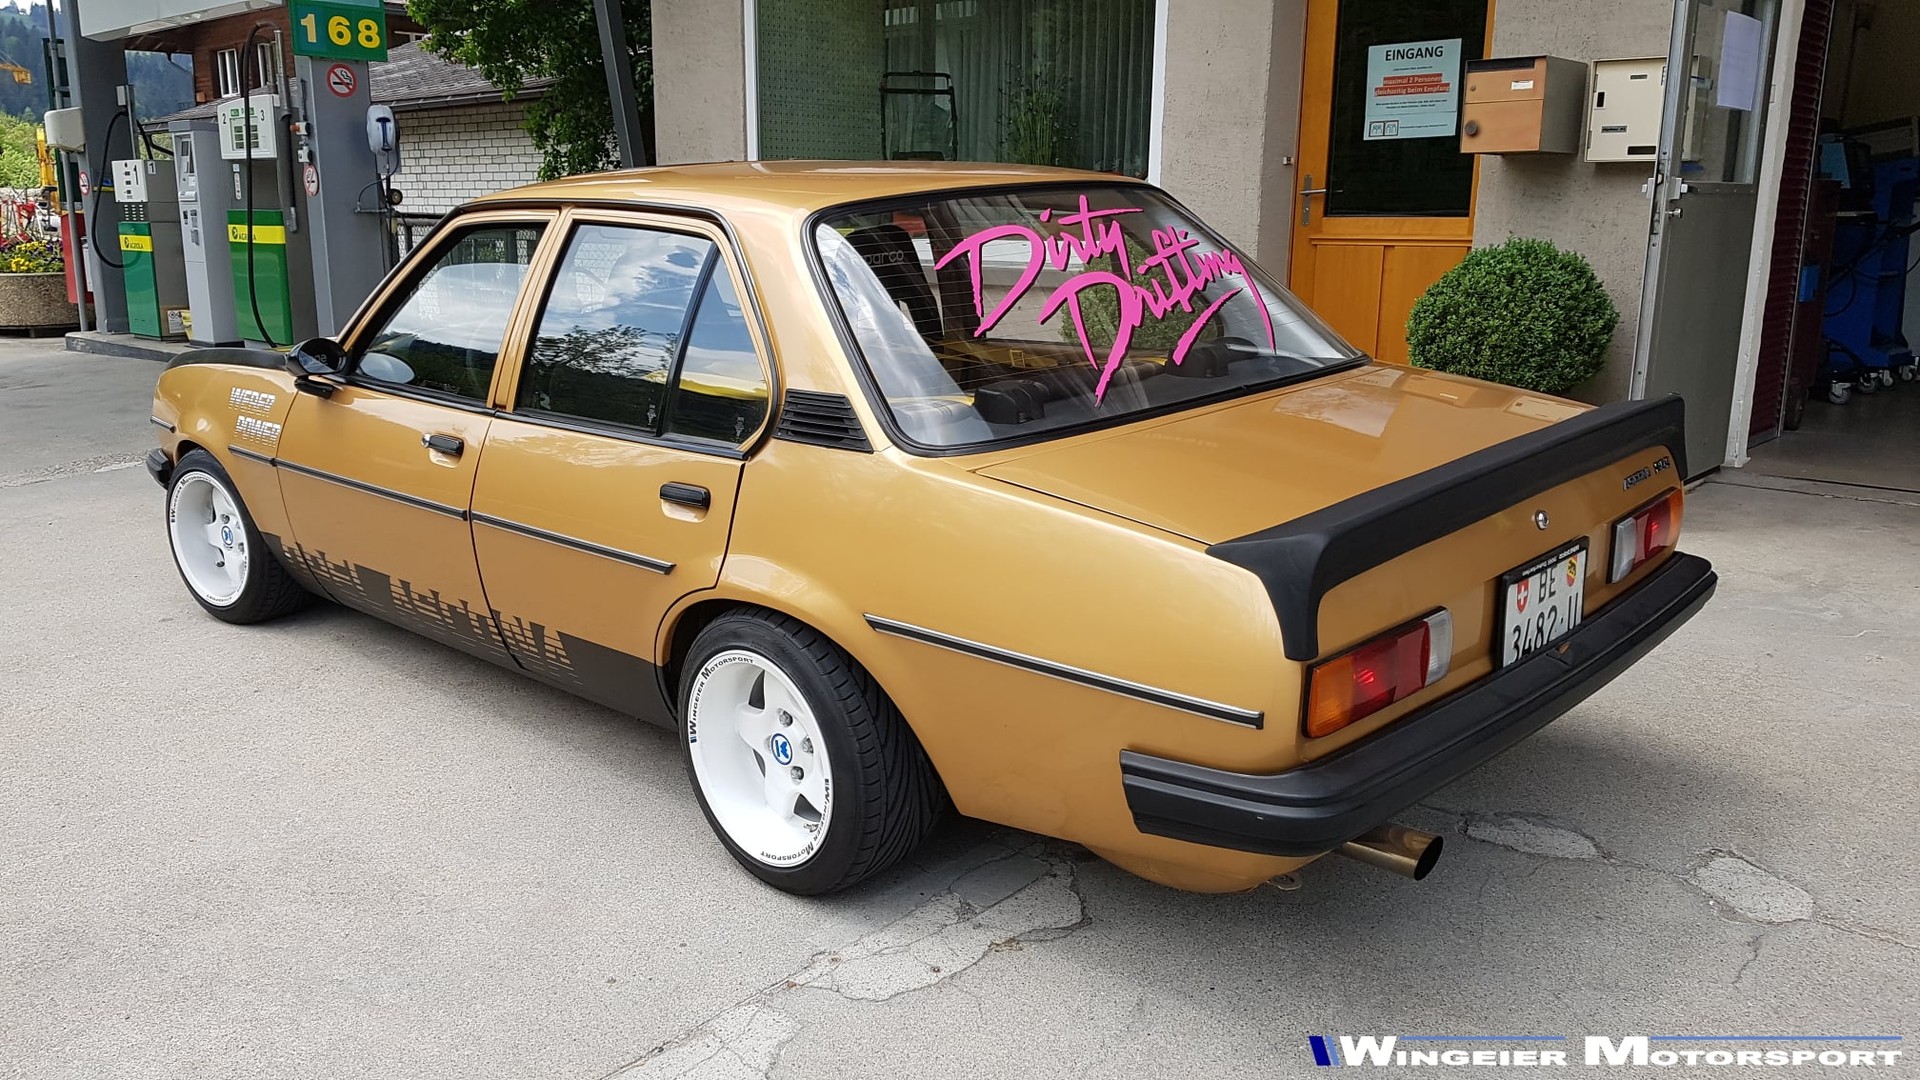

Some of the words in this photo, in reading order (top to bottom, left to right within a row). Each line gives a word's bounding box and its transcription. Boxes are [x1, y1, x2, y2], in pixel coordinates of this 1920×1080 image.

[1385, 45, 1444, 61] EINGANG
[1383, 76, 1409, 85] maximal
[1414, 75, 1443, 83] Personen
[1407, 86, 1423, 94] beim
[222, 113, 227, 125] 2
[260, 109, 265, 122] 3
[148, 162, 155, 174] 1
[933, 194, 1144, 338] Dirty
[1538, 563, 1558, 605] BE
